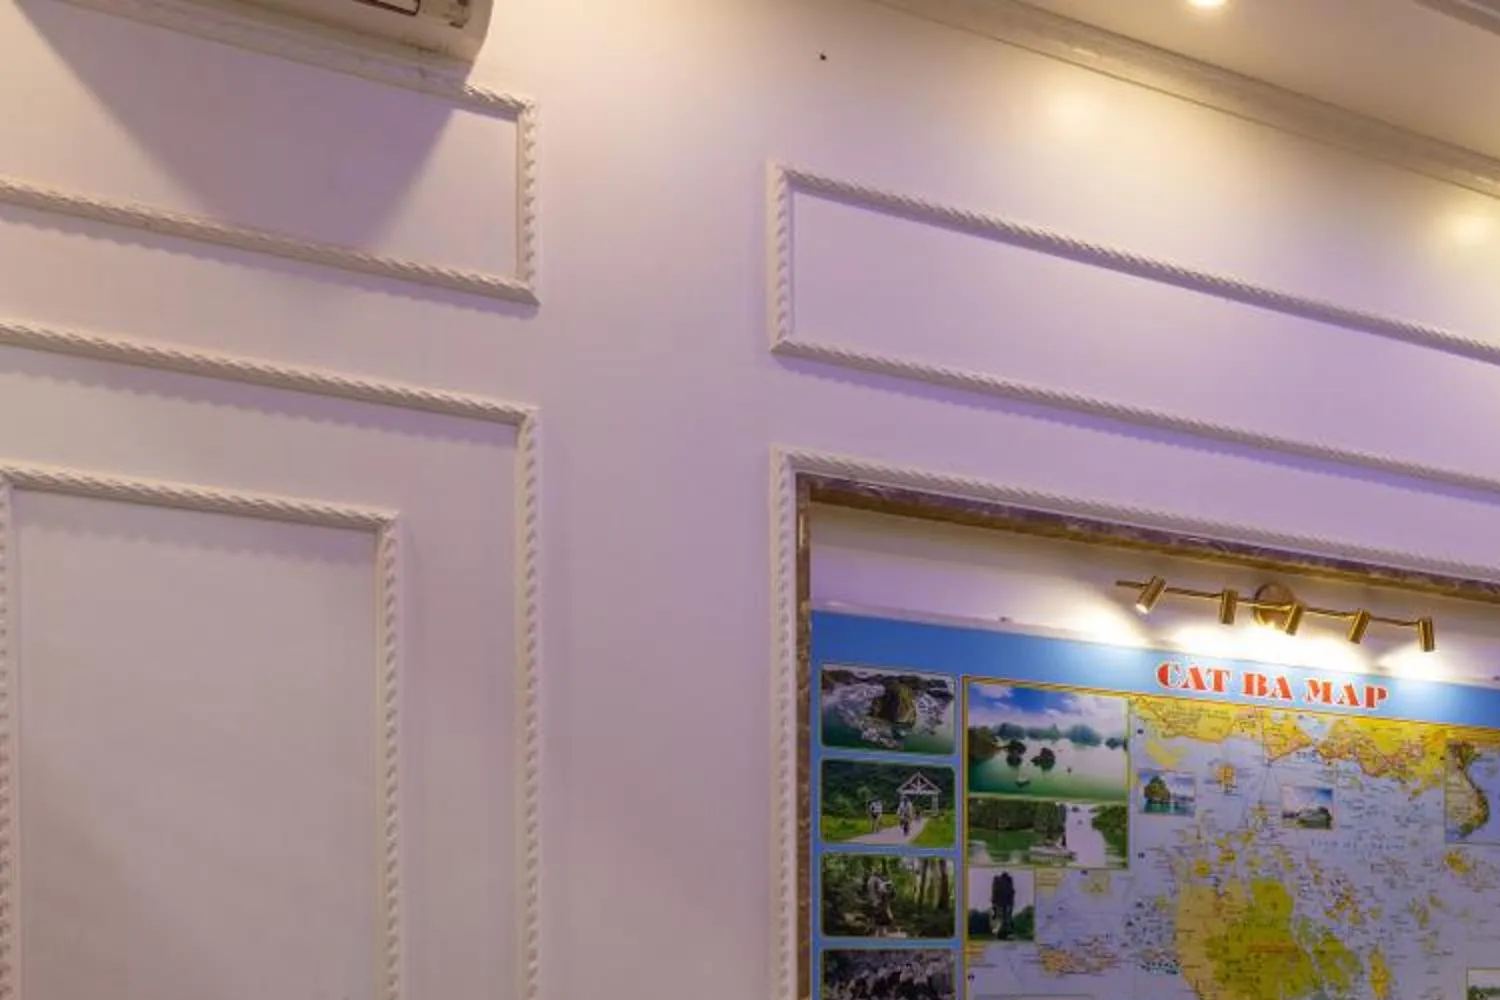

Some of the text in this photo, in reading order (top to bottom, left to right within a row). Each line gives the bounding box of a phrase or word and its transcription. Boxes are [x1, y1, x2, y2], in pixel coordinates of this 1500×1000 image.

[1157, 662, 1388, 709] CAT BA MAP
